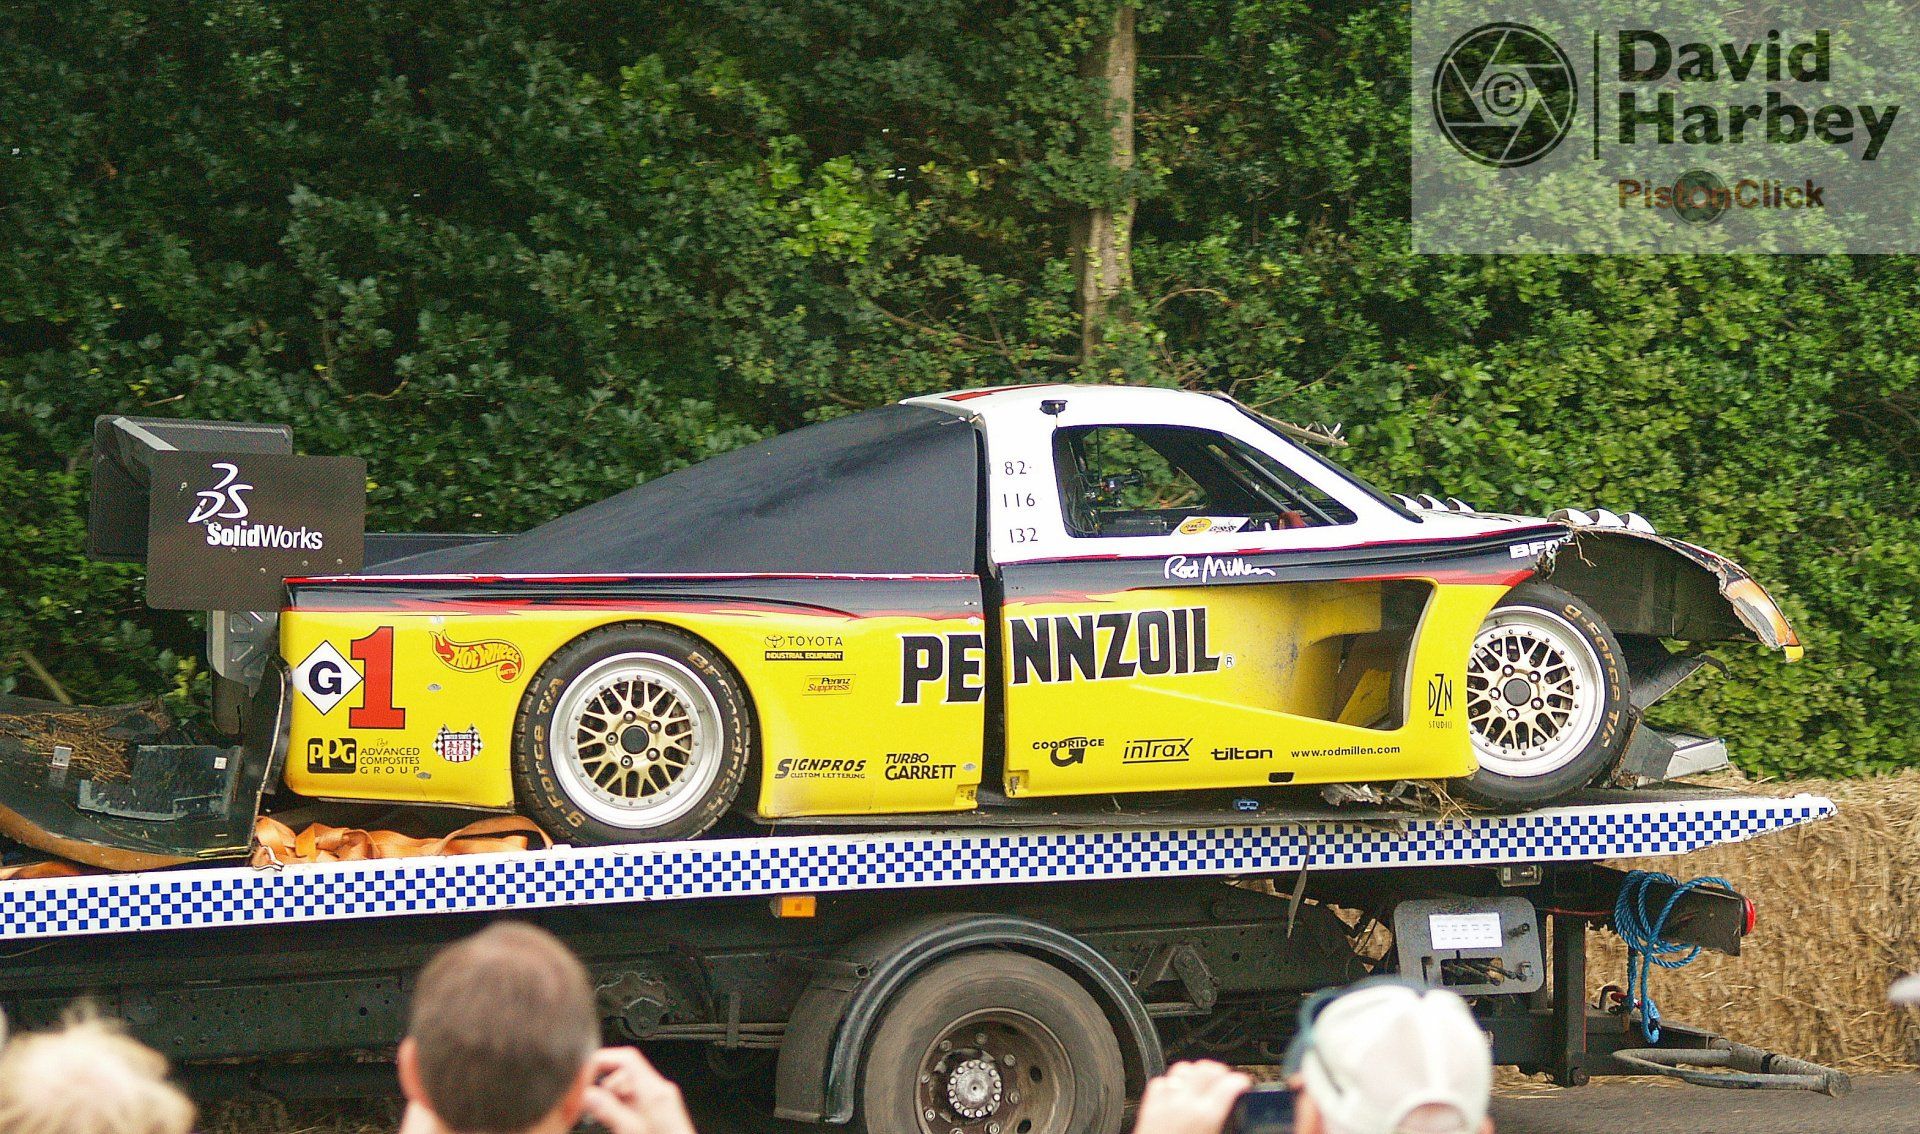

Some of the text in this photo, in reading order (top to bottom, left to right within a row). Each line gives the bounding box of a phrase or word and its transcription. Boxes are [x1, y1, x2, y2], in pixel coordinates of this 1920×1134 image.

[1004, 460, 1027, 476] 82
[1003, 492, 1036, 508] 116
[206, 520, 324, 551] SolidWorks
[1009, 527, 1039, 544] 132
[1164, 555, 1277, 584] Rod Millen
[787, 635, 844, 647] TOYOTA
[766, 651, 842, 660] INDUSTRIAL EQUIPMENT
[308, 660, 342, 695] G
[349, 626, 406, 730] 1
[807, 684, 850, 693] Suppress
[1428, 673, 1453, 717] DZN
[1428, 720, 1453, 730] STUDIO
[360, 747, 420, 756] ADVANCED
[1032, 738, 1105, 751] GOODRIDGE
[1121, 737, 1194, 761] inTrax
[1290, 745, 1401, 759] www.rodmillen.com
[308, 738, 356, 769] PPG
[360, 756, 420, 765] COMPOSITES
[885, 752, 930, 765] TURBO
[1210, 747, 1274, 762] tilton
[360, 765, 420, 775] GROUP
[775, 758, 867, 780] SIGNPROS
[822, 772, 866, 780] LETTERING
[884, 763, 957, 781] GARRETT
